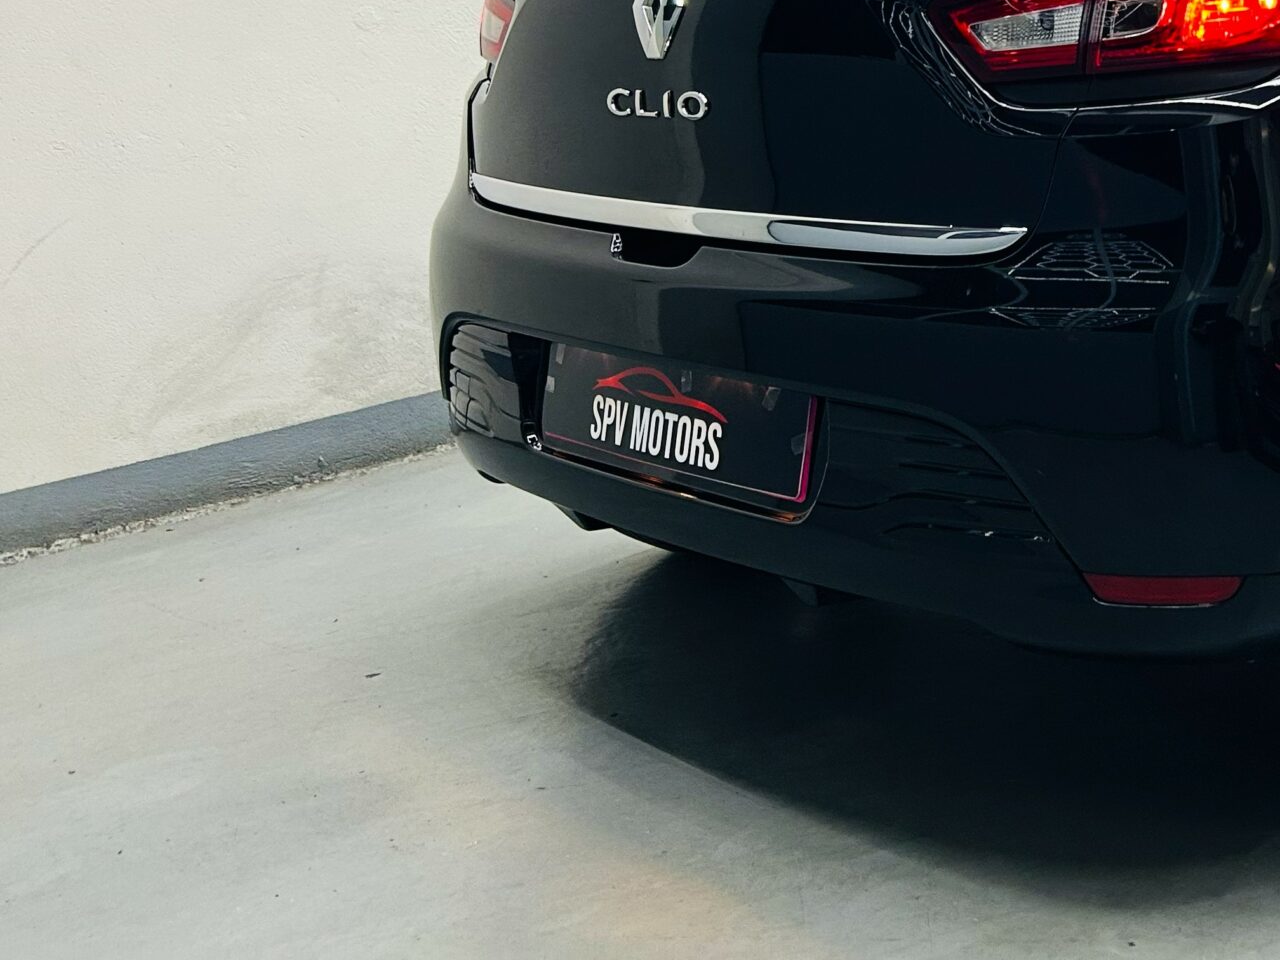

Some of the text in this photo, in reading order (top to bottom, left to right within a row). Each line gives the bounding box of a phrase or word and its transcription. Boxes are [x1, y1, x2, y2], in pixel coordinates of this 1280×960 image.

[607, 88, 708, 120] CLIO
[590, 394, 722, 470] SPV MOTORS
